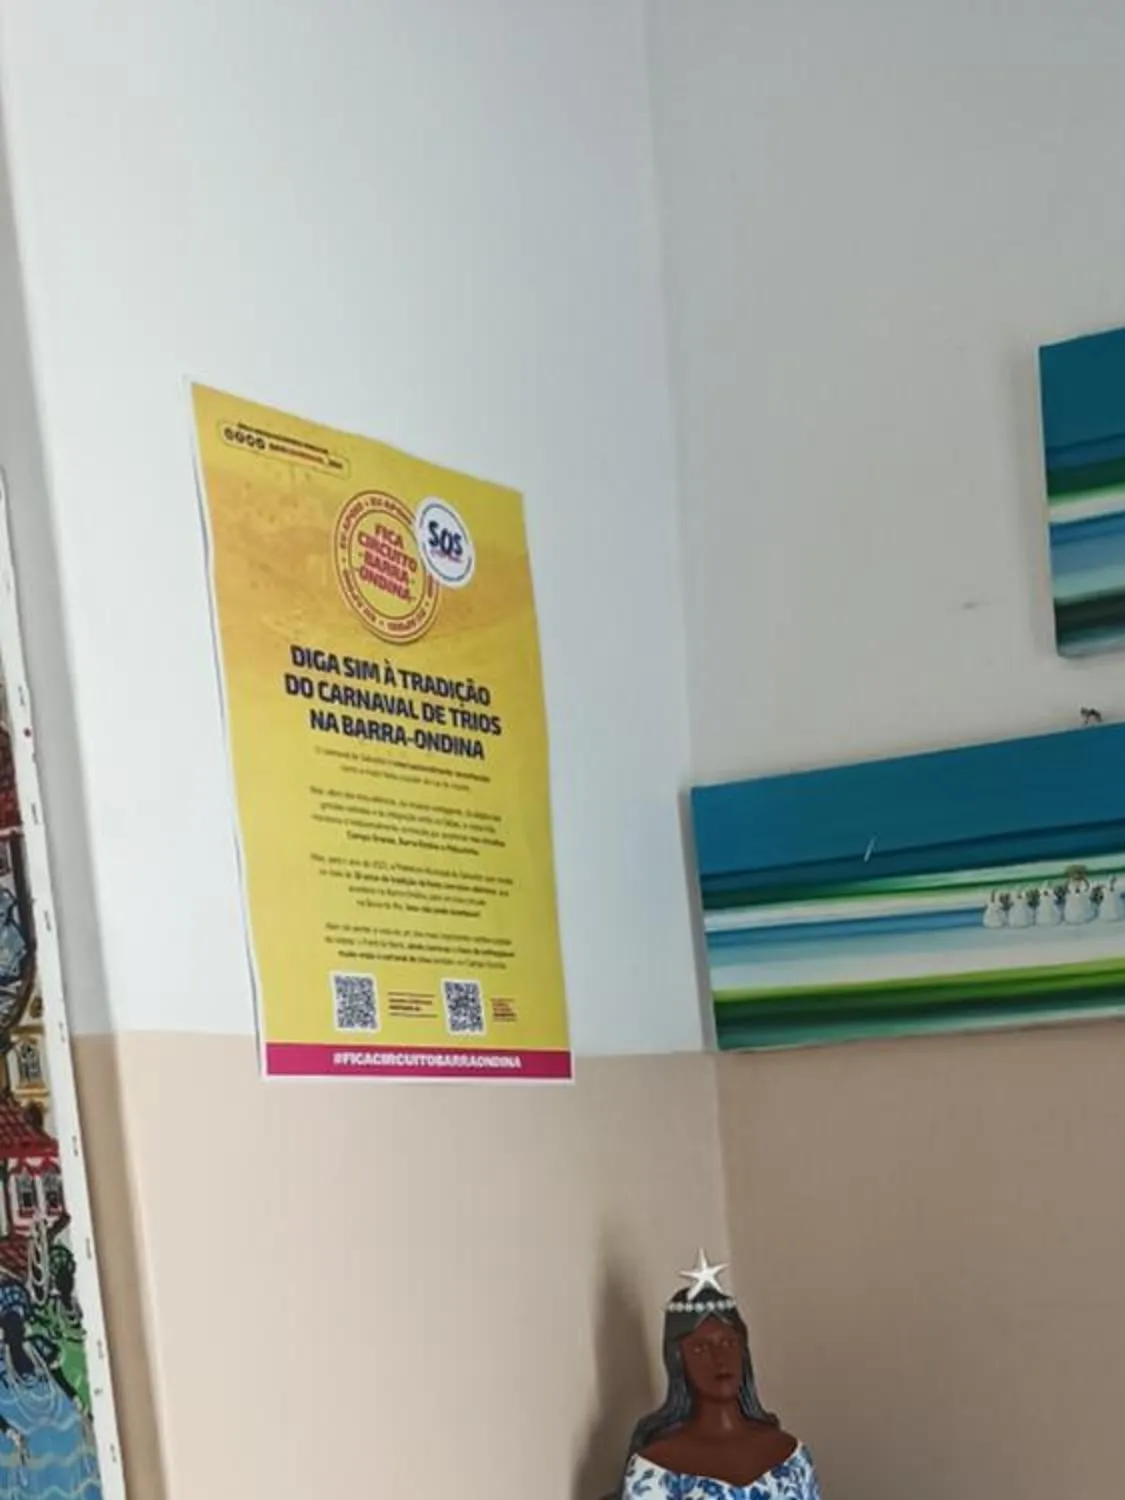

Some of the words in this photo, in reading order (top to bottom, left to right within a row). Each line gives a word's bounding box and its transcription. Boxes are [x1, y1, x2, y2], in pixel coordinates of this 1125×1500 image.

[357, 530, 418, 573] CIRCUITO
[375, 522, 404, 549] FICA
[428, 520, 463, 555] SOS
[290, 644, 340, 675] DIGA
[343, 656, 380, 684] SIM
[383, 658, 396, 688] À
[397, 668, 491, 707] TRADIÇÃO
[284, 673, 314, 699] DO
[317, 681, 419, 720] CARNAVAL
[421, 702, 448, 726] DE
[449, 706, 502, 736] TRIOS
[309, 708, 340, 734] NA
[341, 714, 486, 761] BARRA-ONDINA
[333, 1051, 522, 1069] #FICACIRCUITOBARRAONDINA
